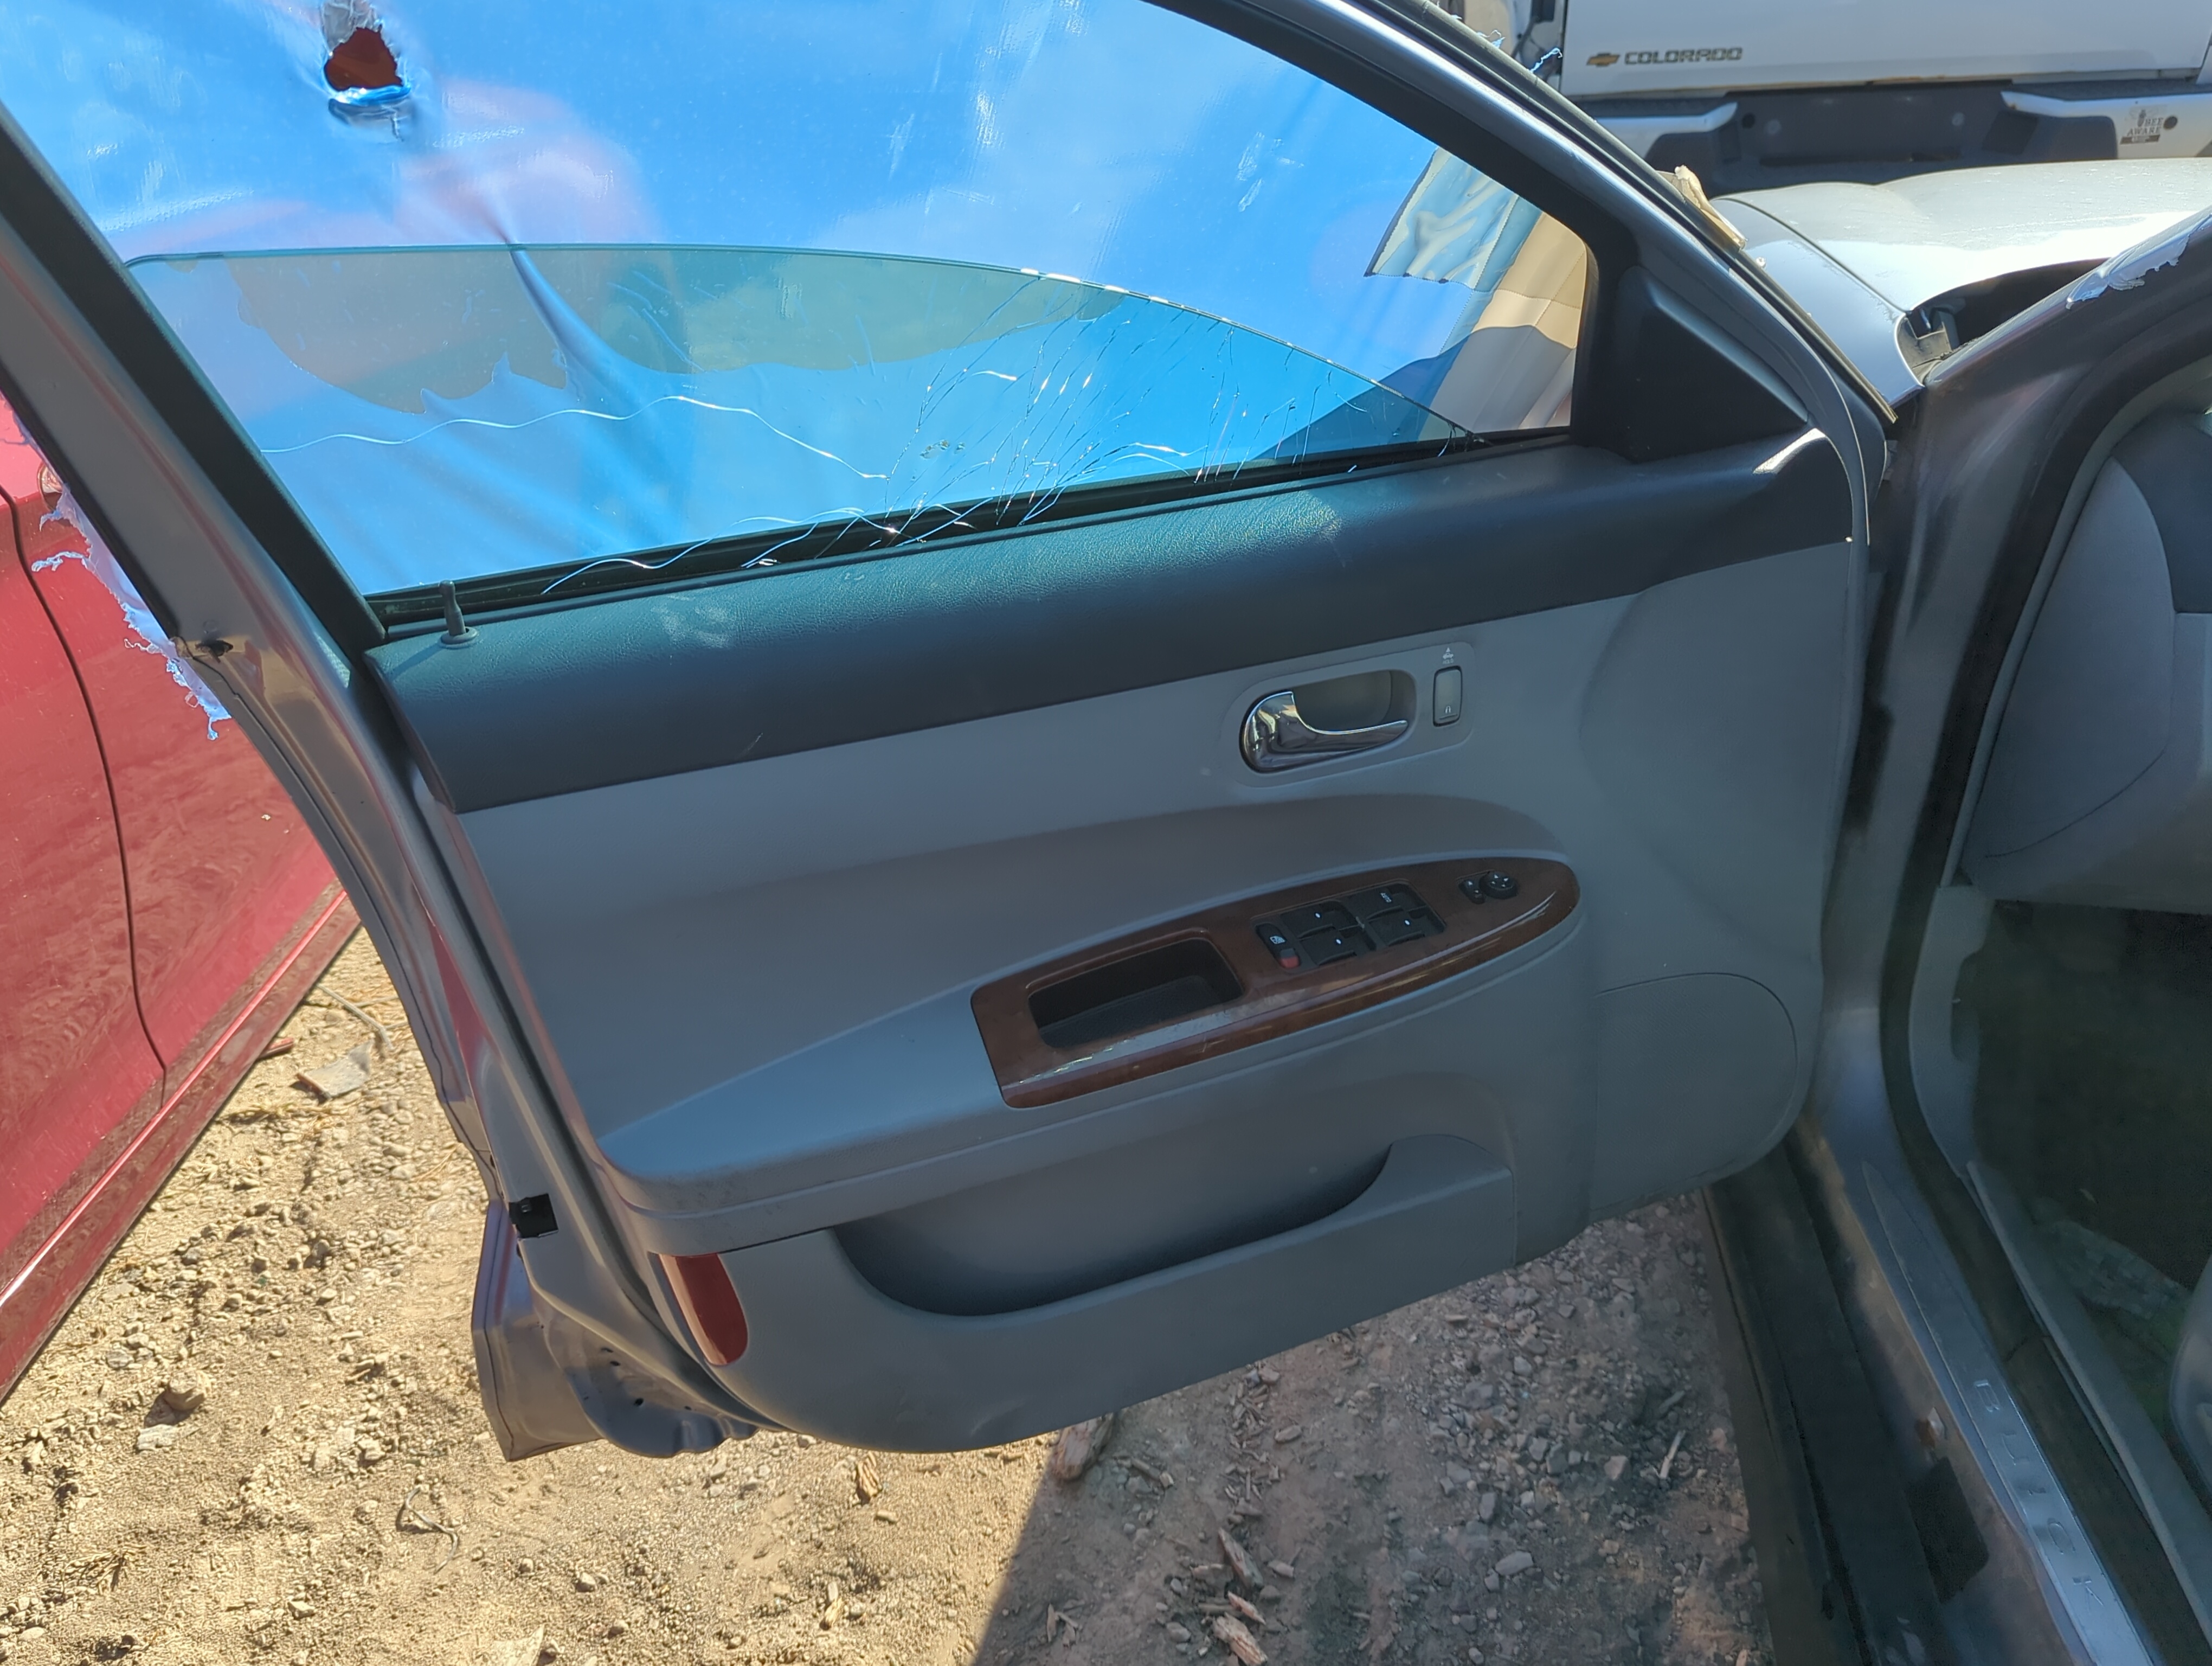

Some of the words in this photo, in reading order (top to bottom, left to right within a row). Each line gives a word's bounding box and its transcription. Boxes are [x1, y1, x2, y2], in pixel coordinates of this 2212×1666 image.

[1624, 47, 1742, 65] COLORADO
[2144, 117, 2164, 127] BEE
[2126, 125, 2160, 137] AWARE
[1380, 893, 1392, 903] AUTO
